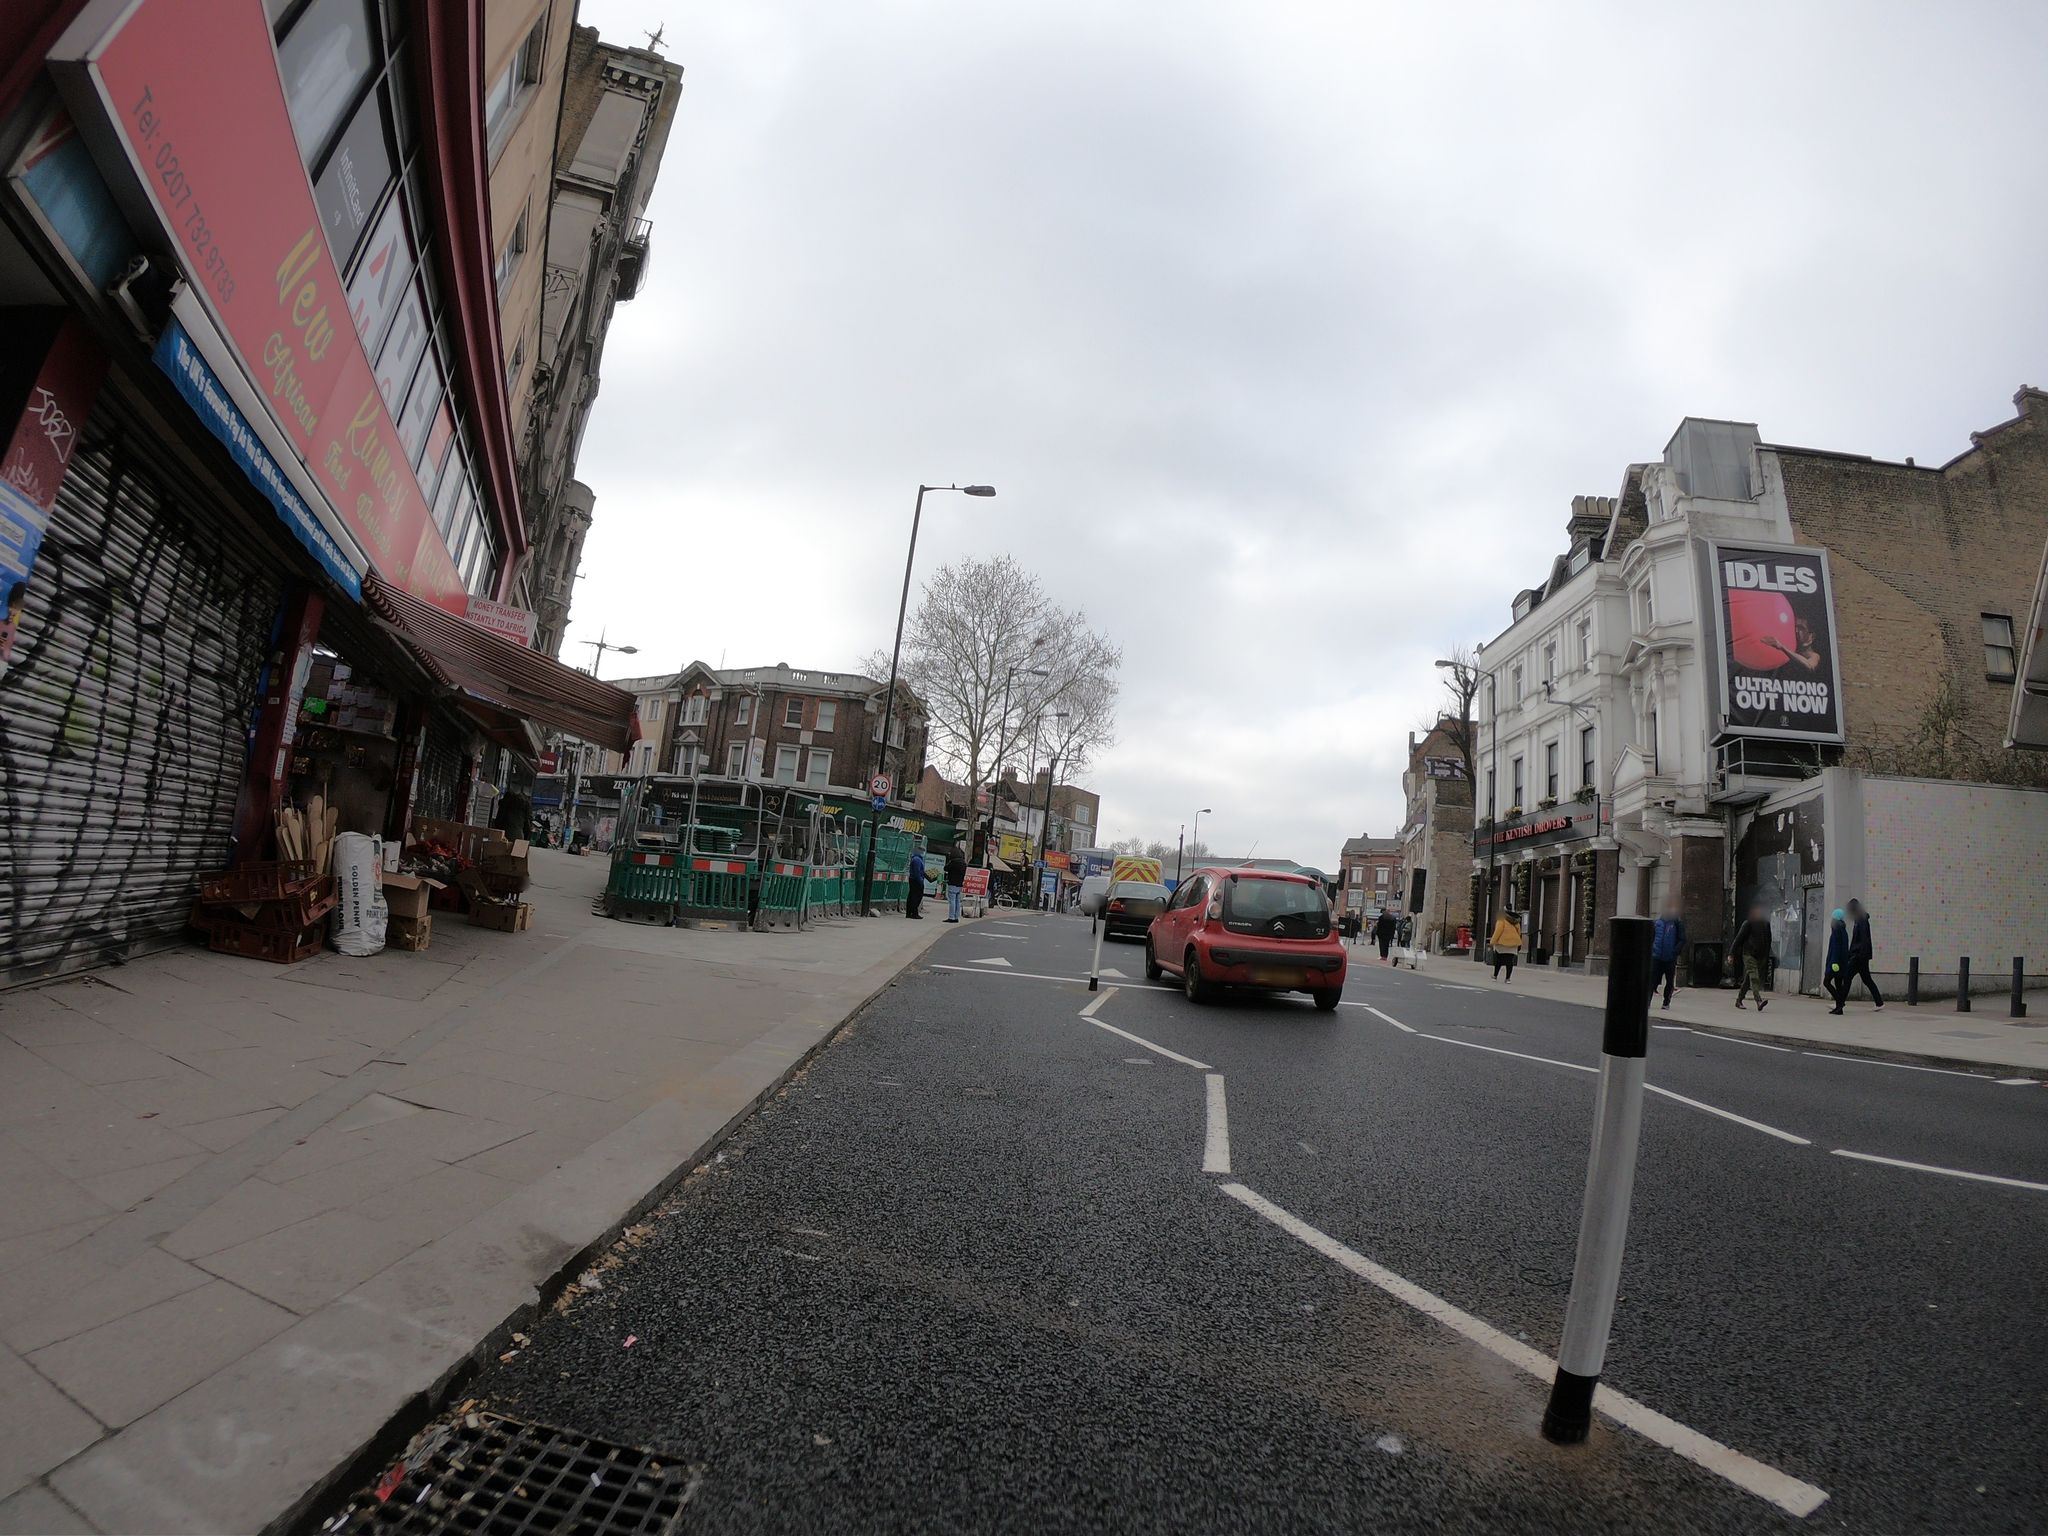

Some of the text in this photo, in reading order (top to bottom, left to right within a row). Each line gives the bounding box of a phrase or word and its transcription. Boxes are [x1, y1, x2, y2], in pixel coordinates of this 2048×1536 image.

[133, 84, 235, 304] Tel: 0207 732 9733
[276, 228, 335, 361] New
[178, 337, 192, 371] The
[1725, 561, 1818, 594] IDLES
[465, 612, 527, 634] NSTANTLY TO AFRICA
[474, 601, 526, 622] MONEY TRANSFER
[1736, 690, 1828, 715] OUT NOW
[613, 780, 631, 790] ZETA
[874, 780, 888, 790] 20
[887, 815, 924, 832] SUBWAY
[1505, 823, 1533, 841] KENTISH
[1534, 816, 1567, 834] DROVERS
[352, 901, 361, 928] PENNY
